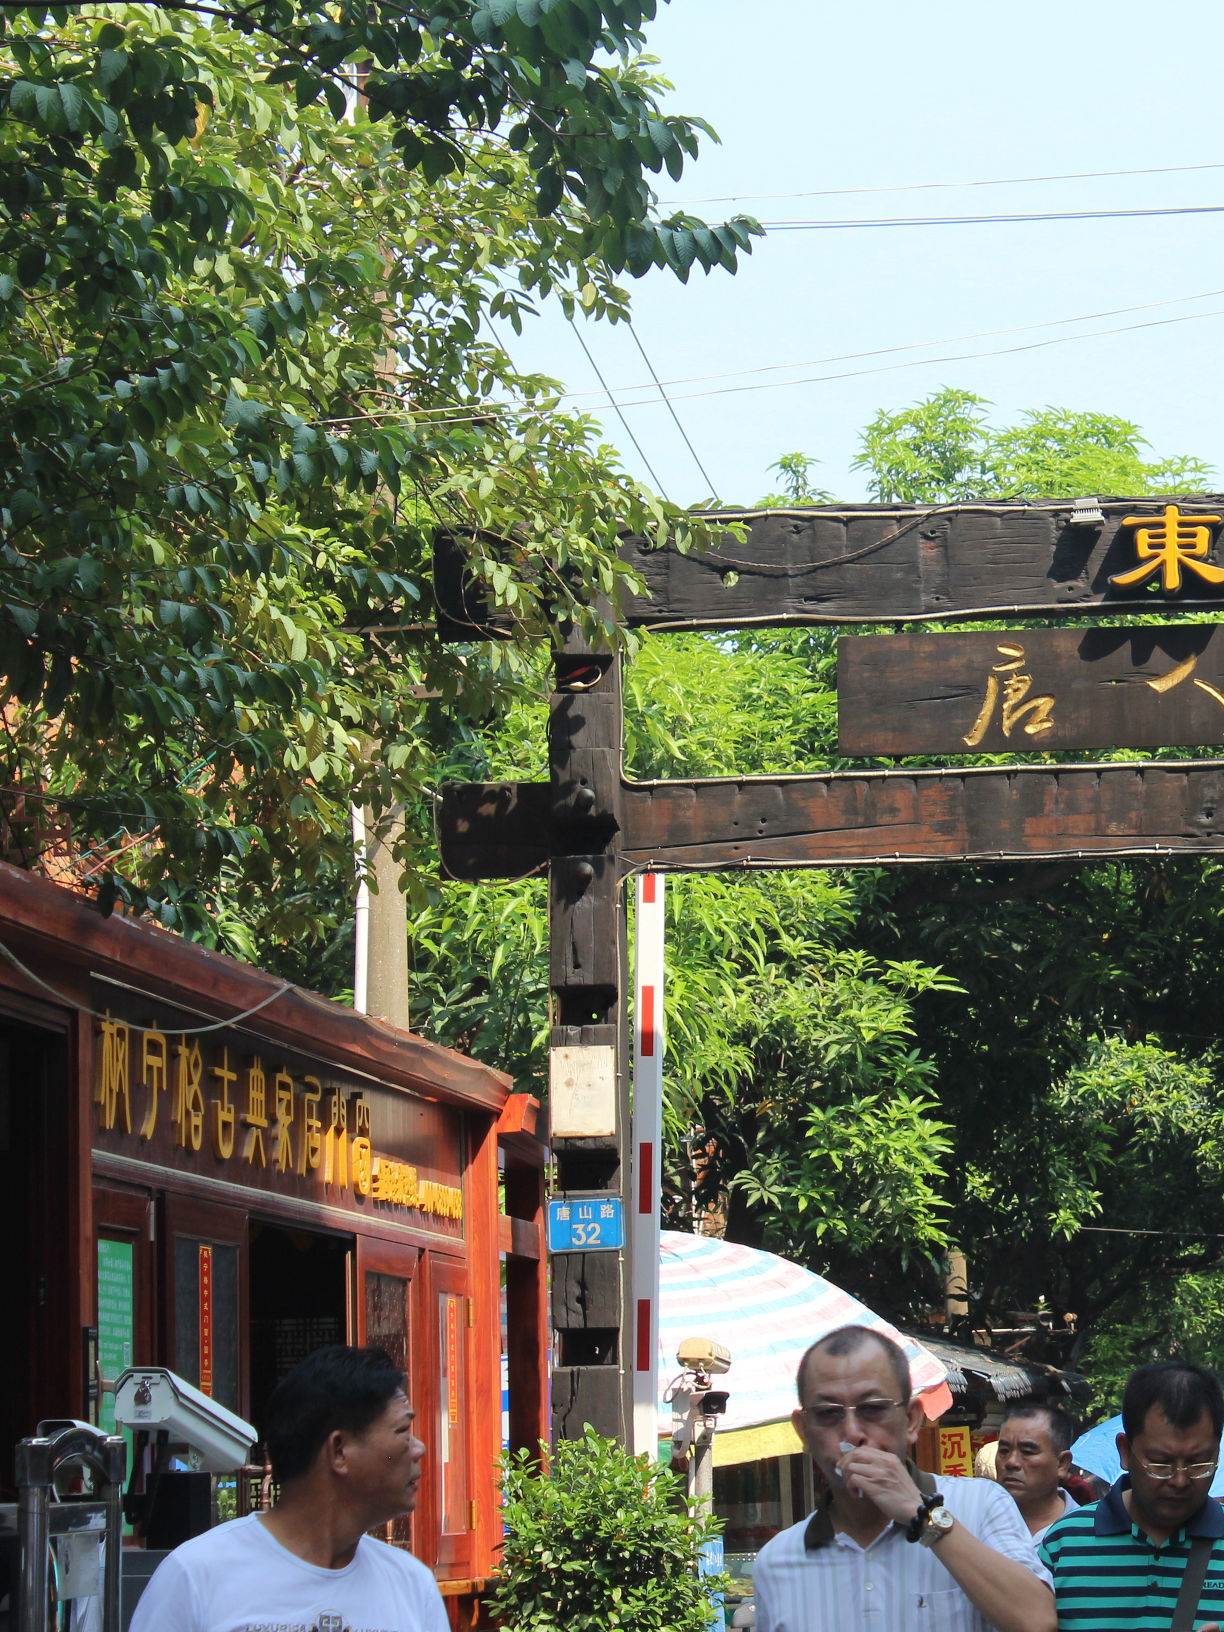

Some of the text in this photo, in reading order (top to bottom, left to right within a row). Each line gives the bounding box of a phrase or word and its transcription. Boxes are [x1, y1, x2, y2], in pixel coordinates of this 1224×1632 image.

[557, 1204, 615, 1221] 唐山路
[571, 1222, 601, 1246] 32
